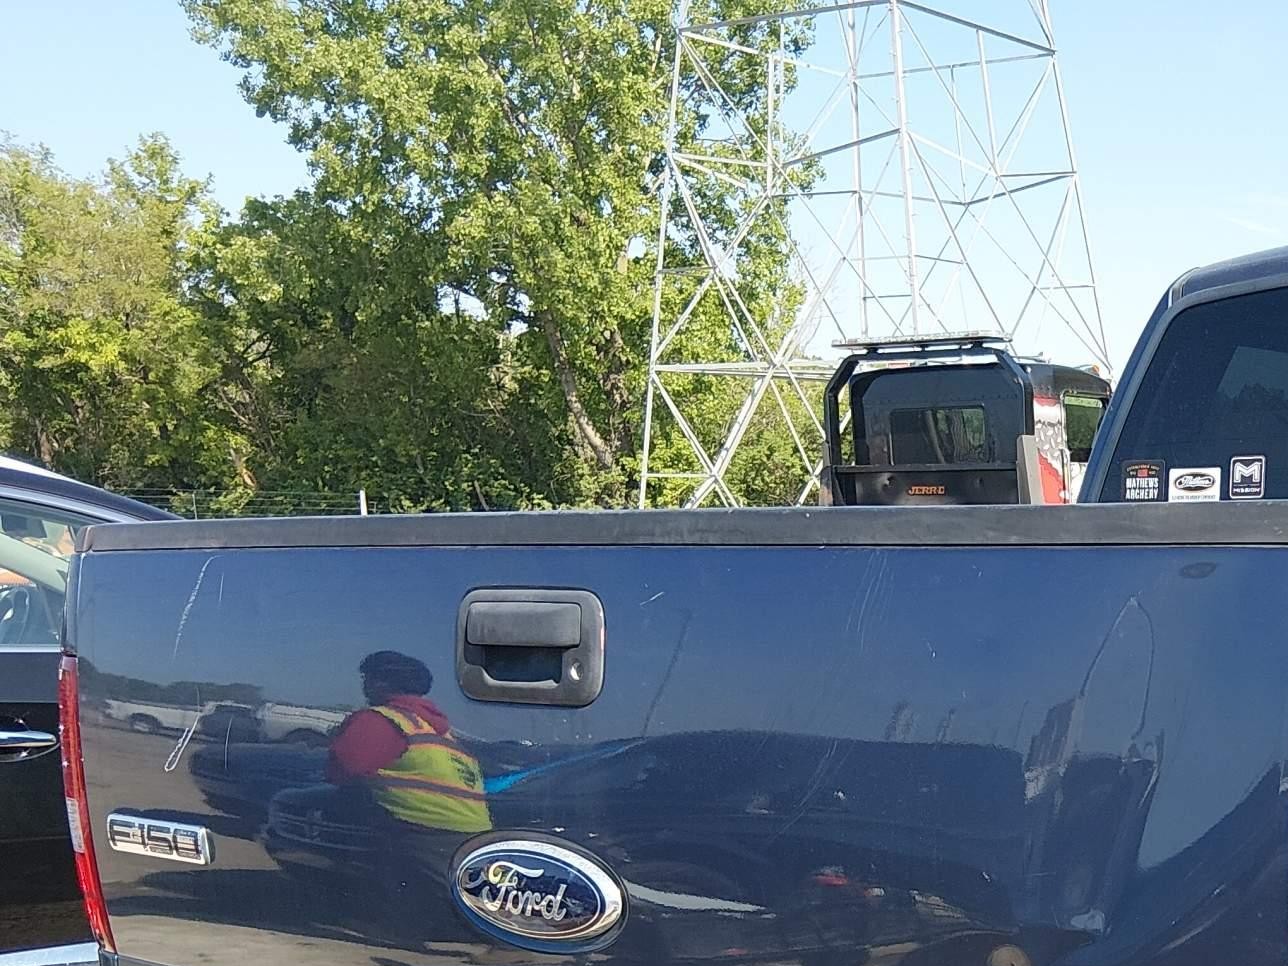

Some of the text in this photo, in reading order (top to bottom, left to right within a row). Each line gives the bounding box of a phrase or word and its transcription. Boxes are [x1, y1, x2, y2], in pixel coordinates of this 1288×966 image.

[1125, 477, 1159, 488] MATHEWS
[1125, 488, 1159, 500] ARCHERY
[482, 861, 567, 921] Ford
